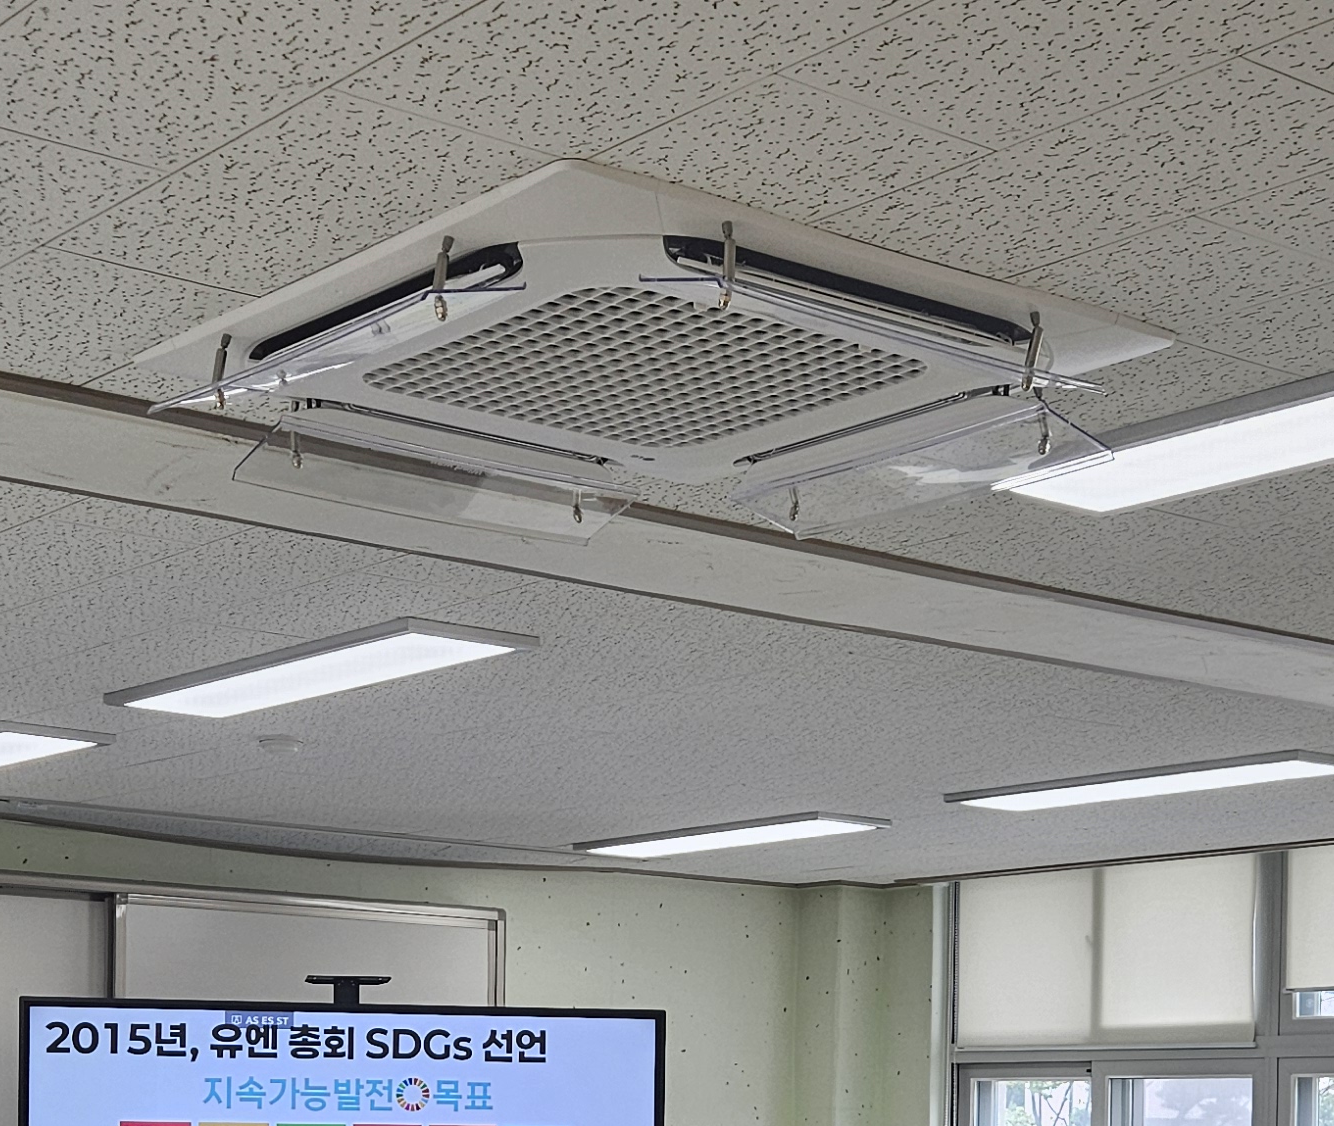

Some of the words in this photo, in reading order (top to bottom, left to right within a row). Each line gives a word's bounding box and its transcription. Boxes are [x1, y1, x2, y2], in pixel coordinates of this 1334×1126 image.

[45, 1021, 199, 1062] 2015년,
[210, 1023, 278, 1059] 유엔
[288, 1024, 355, 1060] 총회
[366, 1028, 473, 1060] SDGs
[482, 1029, 547, 1063] 선언
[203, 1076, 394, 1112] 지속가능발전
[433, 1080, 494, 1112] 목표
